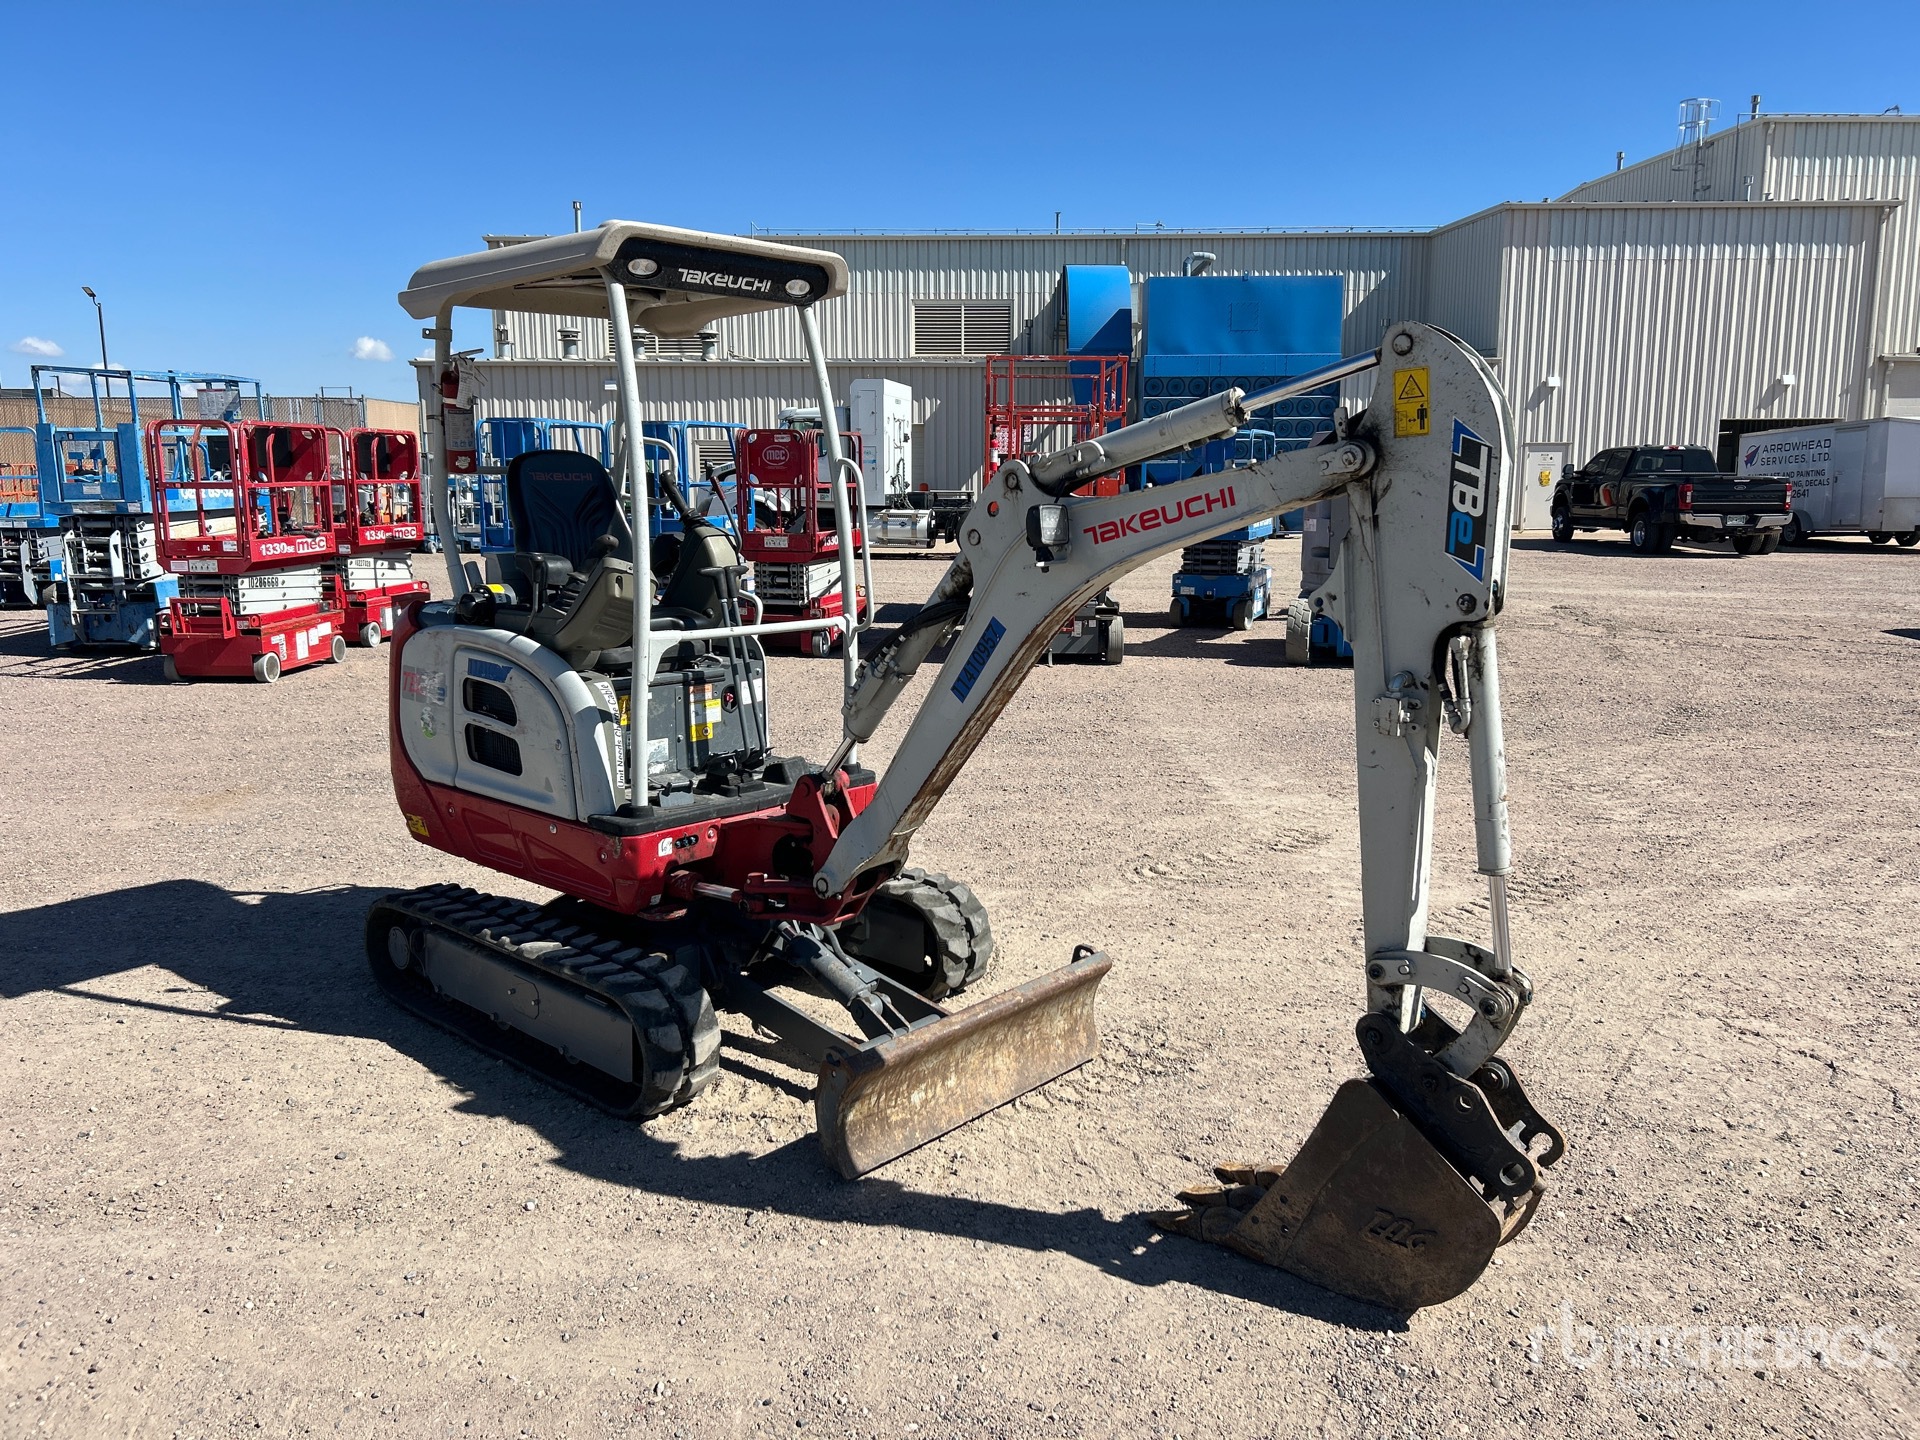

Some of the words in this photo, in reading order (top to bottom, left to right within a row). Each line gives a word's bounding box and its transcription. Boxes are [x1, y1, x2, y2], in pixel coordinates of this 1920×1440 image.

[1762, 439, 1832, 454] ARROWHEAD
[1812, 452, 1831, 463] LTD.
[1797, 469, 1826, 478] PAINTING
[1805, 478, 1830, 487] DECALS
[394, 527, 416, 539] mec
[297, 537, 326, 553] mec
[600, 684, 617, 706] Cable
[615, 740, 624, 767] Needs
[616, 769, 625, 788] Unit
